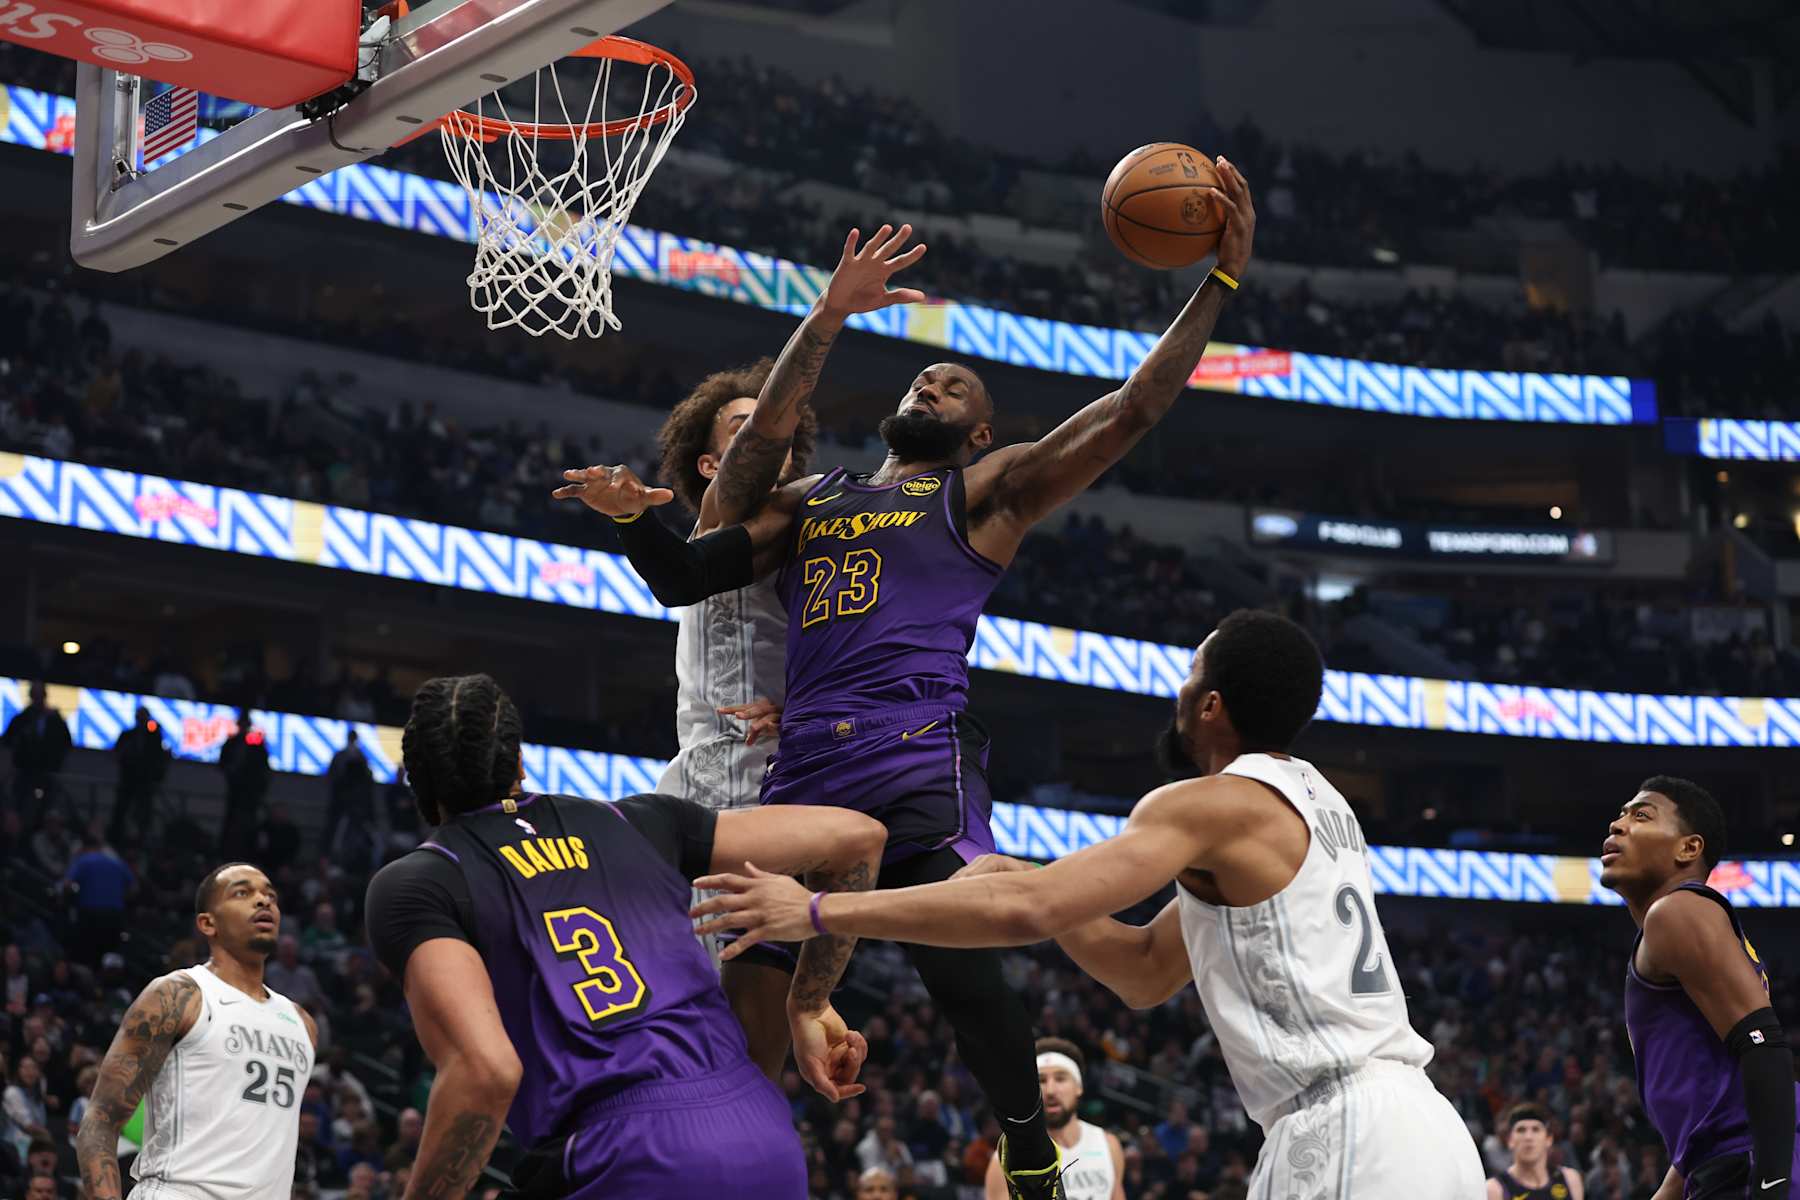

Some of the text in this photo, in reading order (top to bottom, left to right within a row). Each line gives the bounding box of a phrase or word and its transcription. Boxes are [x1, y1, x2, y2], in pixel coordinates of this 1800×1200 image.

[905, 481, 938, 491] bibigo
[802, 548, 882, 629] 23
[499, 836, 590, 879] DAVIS
[543, 906, 646, 1021] 3
[224, 1024, 309, 1075] MAVS
[241, 1060, 296, 1109] 25
